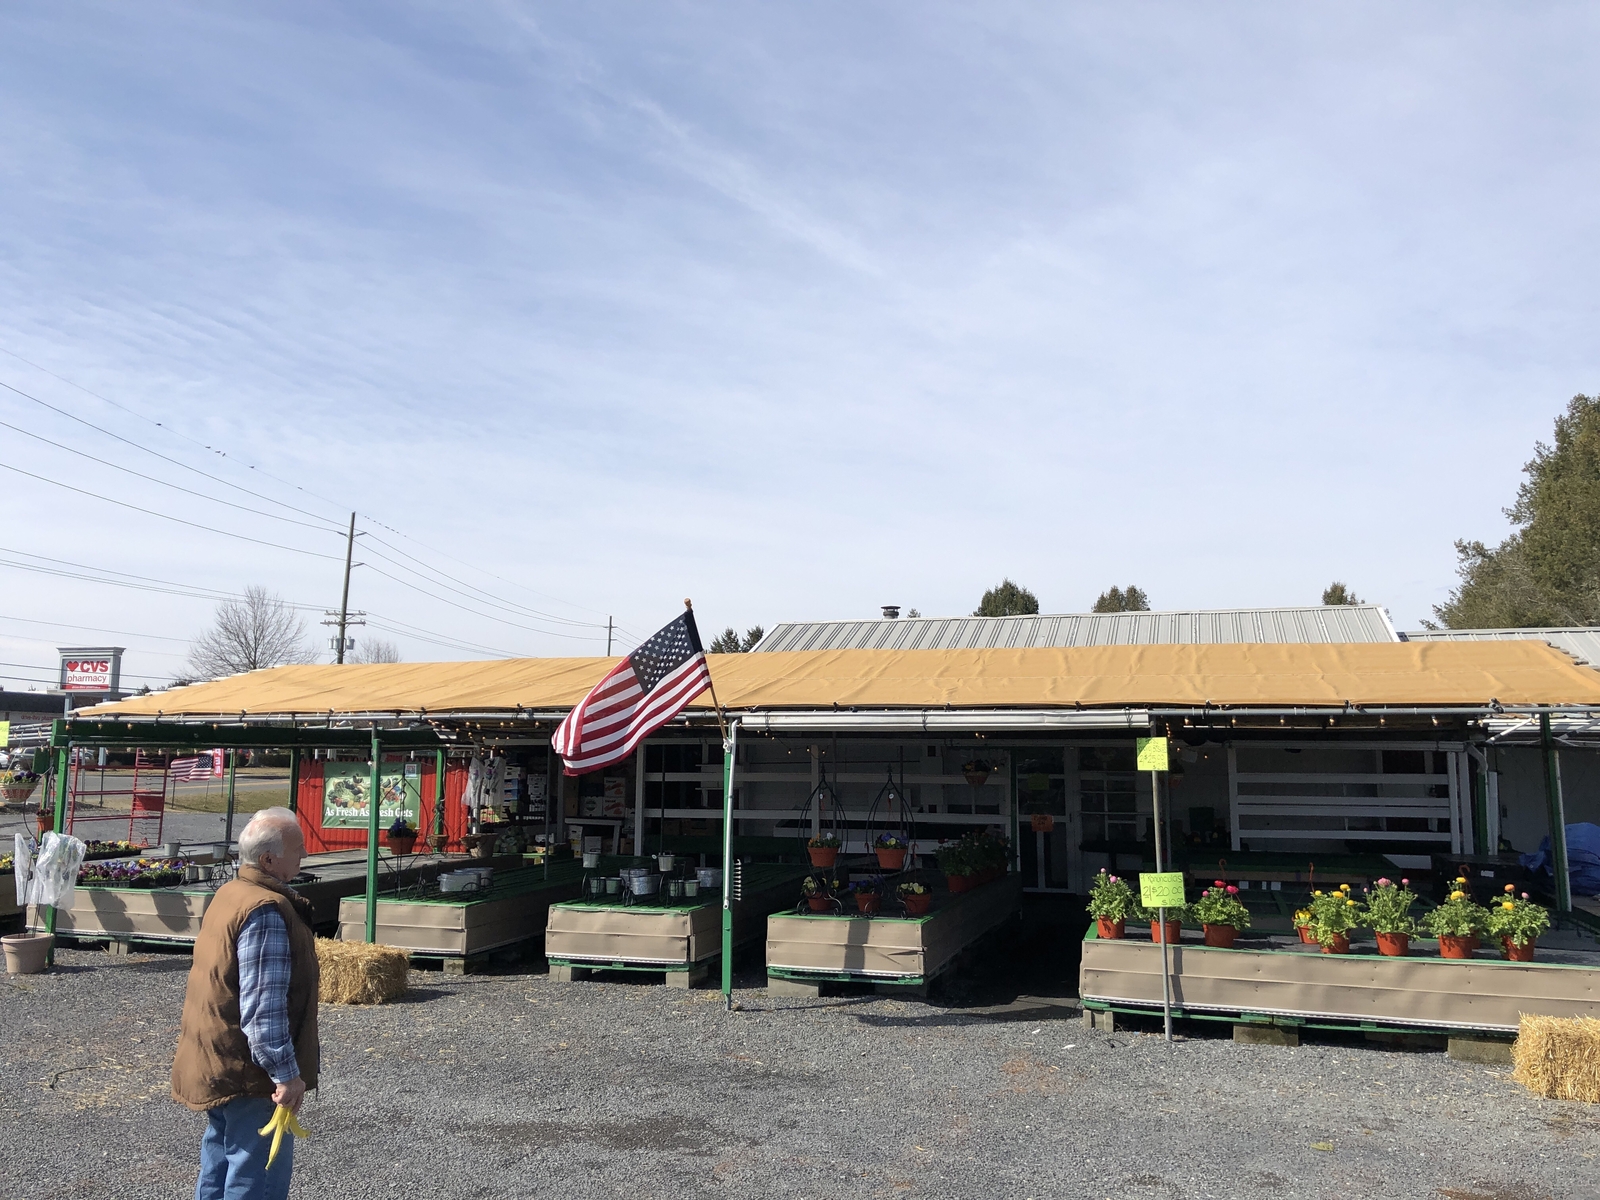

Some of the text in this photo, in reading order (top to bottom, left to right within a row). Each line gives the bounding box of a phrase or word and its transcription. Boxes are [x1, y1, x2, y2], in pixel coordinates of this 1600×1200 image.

[80, 660, 108, 672] CVS
[67, 674, 107, 684] pharmacy
[324, 806, 335, 816] As
[336, 806, 358, 816] Fresh
[359, 807, 370, 816] As
[394, 808, 413, 818] Gets
